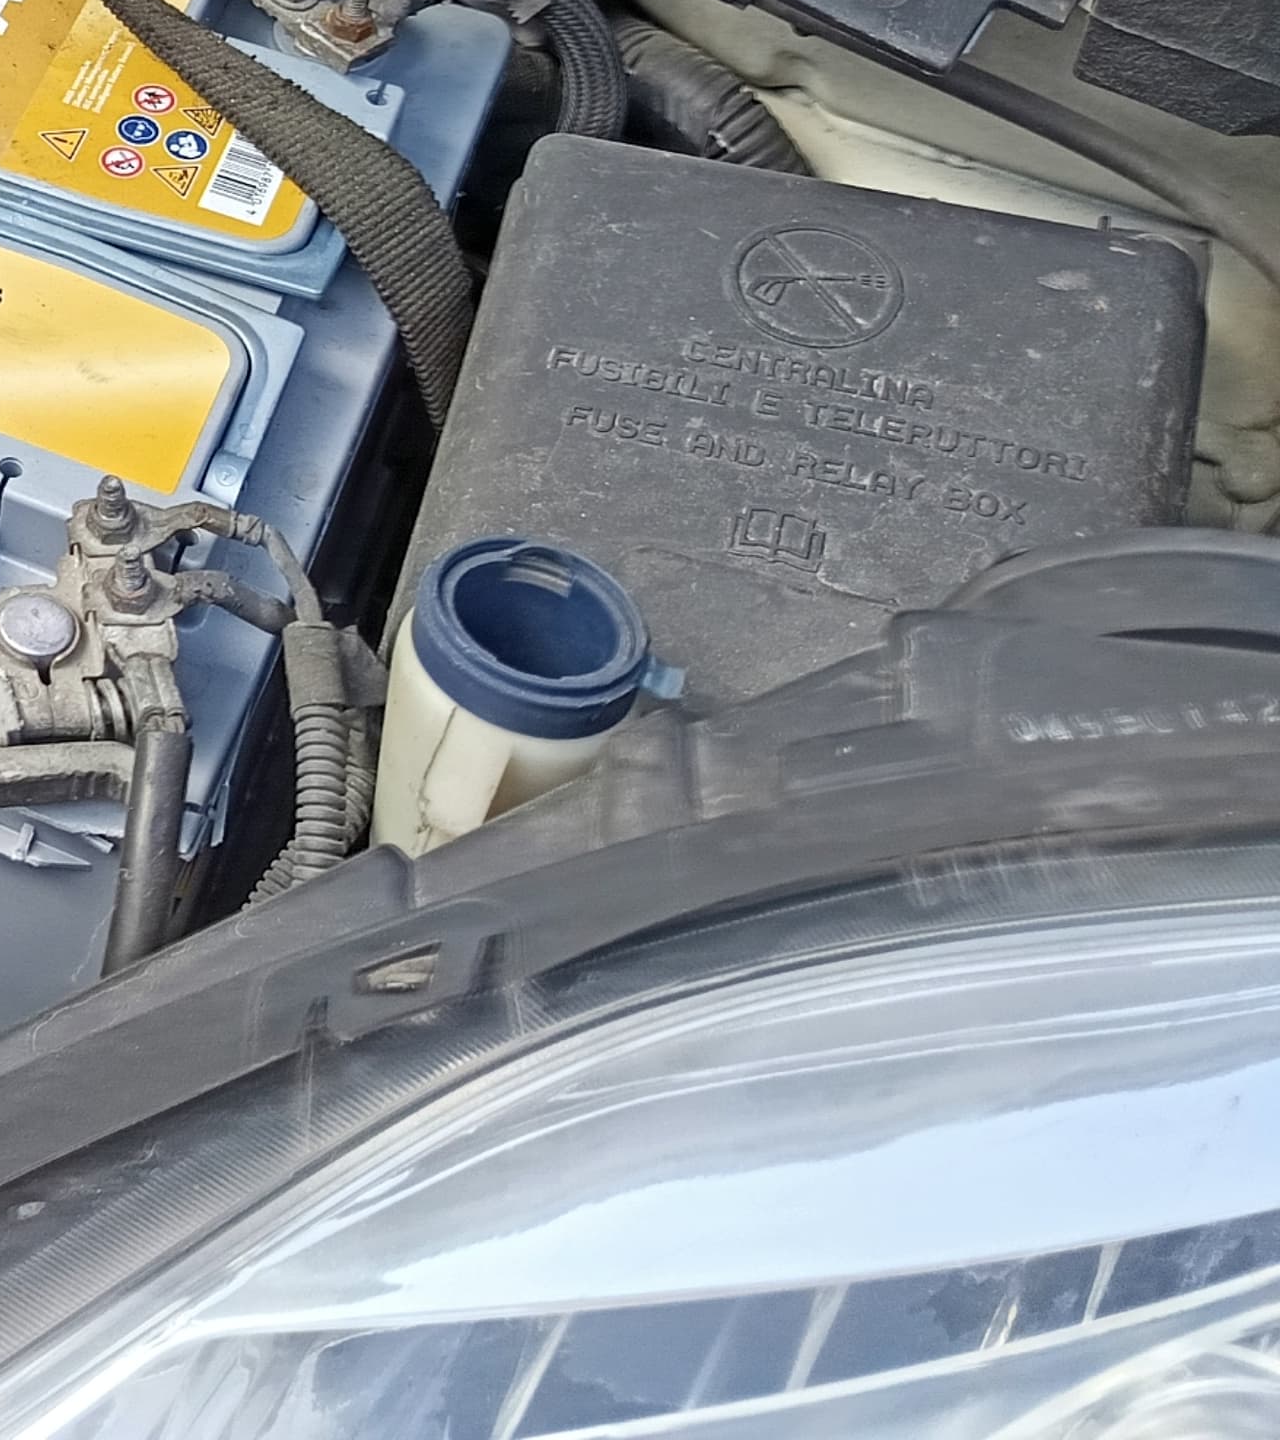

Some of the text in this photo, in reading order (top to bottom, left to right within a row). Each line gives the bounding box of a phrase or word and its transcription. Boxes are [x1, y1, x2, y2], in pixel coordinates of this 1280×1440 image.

[547, 346, 1090, 483] FUSIBILI E TELERUTTORI
[685, 340, 935, 411] CENTRALINA
[565, 405, 1028, 526] FUSE AND RELAY BOX
